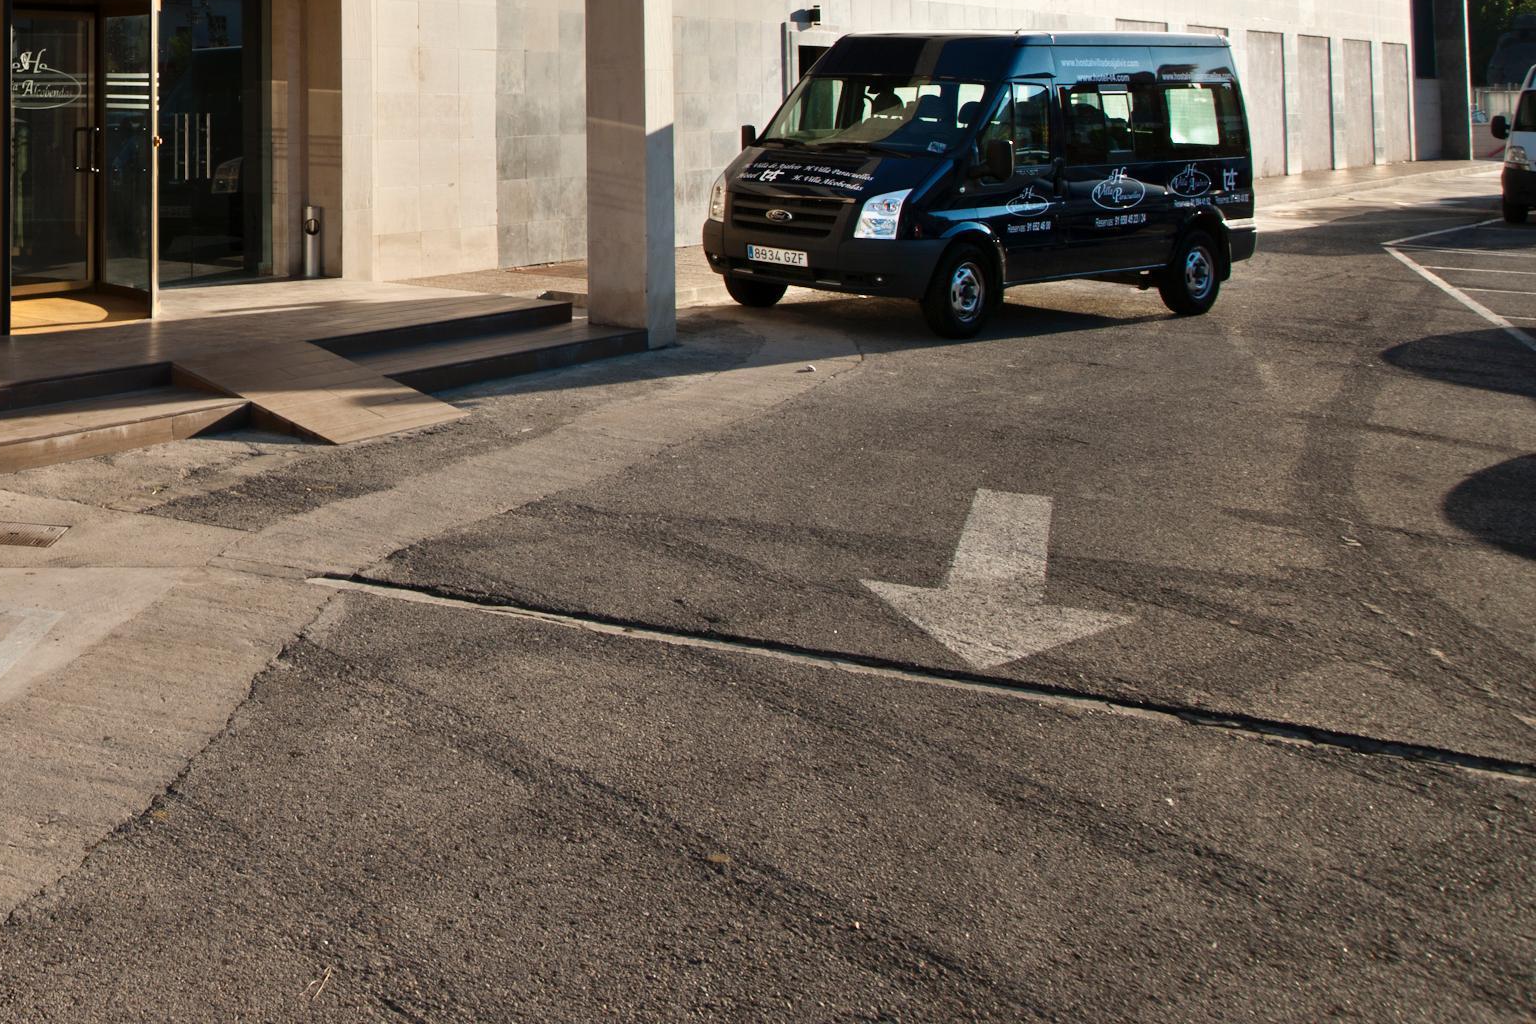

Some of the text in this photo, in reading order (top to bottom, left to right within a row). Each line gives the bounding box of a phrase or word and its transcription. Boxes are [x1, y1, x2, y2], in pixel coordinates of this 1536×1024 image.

[759, 168, 785, 182] t4
[1223, 168, 1239, 192] t4
[754, 247, 805, 264] 8934 GZF
